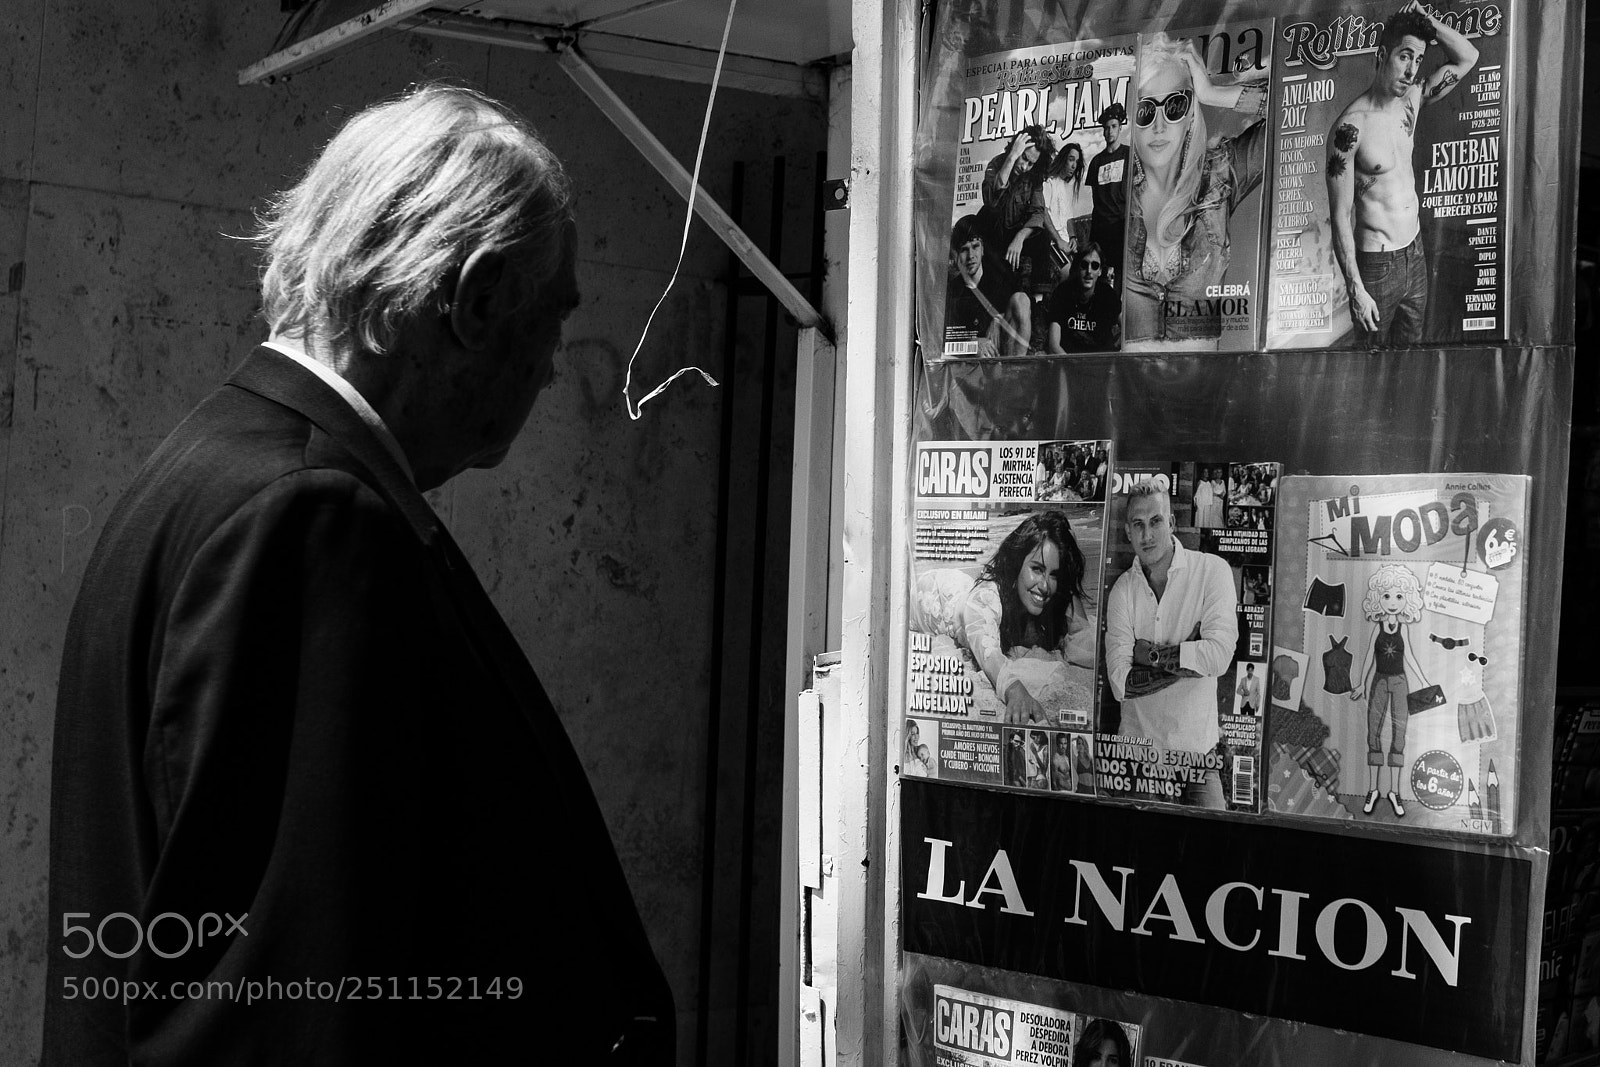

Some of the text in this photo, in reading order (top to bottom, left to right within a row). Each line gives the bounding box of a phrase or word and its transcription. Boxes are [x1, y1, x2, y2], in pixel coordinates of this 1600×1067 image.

[1283, 13, 1385, 69] Rollin
[1198, 28, 1267, 76] na
[966, 45, 1134, 78] ESPECIAL PARA COLECCIONISTAS
[1478, 71, 1501, 83] EL AÑO
[1281, 78, 1335, 107] ANUARIO
[1470, 81, 1501, 94] DEL TRAP
[1477, 91, 1500, 102] LATINO
[961, 76, 1130, 143] PEARL JAM
[1281, 105, 1308, 128] 2017
[1459, 108, 1501, 121] FATS DOMINO:
[1280, 133, 1324, 150] LOS MEJORES
[1431, 136, 1500, 168] ESTEBAN
[1422, 162, 1499, 194] LAMOTHE
[1444, 193, 1463, 206] HICE
[1465, 192, 1476, 204] YO
[1477, 190, 1498, 203] PARA
[1433, 201, 1498, 218] MERECER ESTO?
[1284, 214, 1309, 227] LIBROS
[1477, 227, 1497, 236] DANTE
[1293, 237, 1302, 248] LA
[1468, 236, 1497, 246] SPINETTA
[1277, 248, 1303, 260] GUERRA
[1478, 252, 1497, 261] DIPLO
[1276, 259, 1296, 270] SUCIA
[1479, 268, 1497, 277] DAVID
[1280, 281, 1318, 295] SANTIAGO
[1477, 277, 1497, 286] BOWIE
[1206, 281, 1250, 297] CELEBRÁ
[1279, 292, 1328, 307] MALDONADO
[1465, 293, 1497, 303] FERNANDO
[1165, 298, 1249, 318] EL AMOR
[1467, 303, 1481, 312] RUIZ
[1000, 447, 1036, 459] LOS 91 DE
[919, 450, 990, 495] CARAS
[1002, 460, 1035, 472] MIRTHA:
[992, 473, 1034, 485] ASISTENCIA
[999, 486, 1034, 498] PERFECTA
[1445, 483, 1465, 492] Annie
[1326, 485, 1361, 522] Mi
[917, 510, 988, 520] EXCLUSIVO EN MIAMI
[1212, 529, 1225, 537] TODA
[1233, 530, 1258, 538] INTIMIDAD
[1259, 531, 1268, 539] DEL
[1218, 544, 1268, 553] HERMANAS LEGRAND
[1251, 538, 1258, 546] DE
[1259, 538, 1268, 546] LAS
[1244, 605, 1265, 614] ABRAZO
[1246, 613, 1253, 621] DE
[1248, 620, 1253, 628] Y
[911, 633, 931, 653] LALI
[911, 653, 964, 676] ESPOSITO:
[932, 674, 973, 697] SIENTO
[911, 693, 973, 716] ANGELADA"
[1224, 722, 1256, 732] COMPLICADO
[953, 741, 1000, 754] AMORES NUEVOS:
[940, 749, 957, 760] CANDE
[958, 751, 974, 761] TINELLI
[1138, 746, 1159, 763] NO
[1164, 750, 1224, 770] ESTAMOS
[943, 759, 948, 769] Y
[948, 759, 969, 771] CUBERO
[1417, 761, 1426, 772] A
[1426, 766, 1449, 779] partir
[1130, 761, 1139, 776] Y
[1142, 762, 1178, 782] CADA
[1180, 768, 1206, 784] VEZ
[1136, 778, 1187, 797] MENOS"
[1416, 780, 1427, 790] los
[1428, 776, 1438, 793] 6
[917, 837, 1472, 987] LA NACION
[937, 998, 1012, 1058] CARAS
[1020, 1012, 1071, 1031] DESOLADORA
[1030, 1027, 1070, 1046] DESPEDIDA
[1031, 1042, 1070, 1058] A DEBORA
[1015, 1050, 1070, 1067] PEREZ VOLPIN
